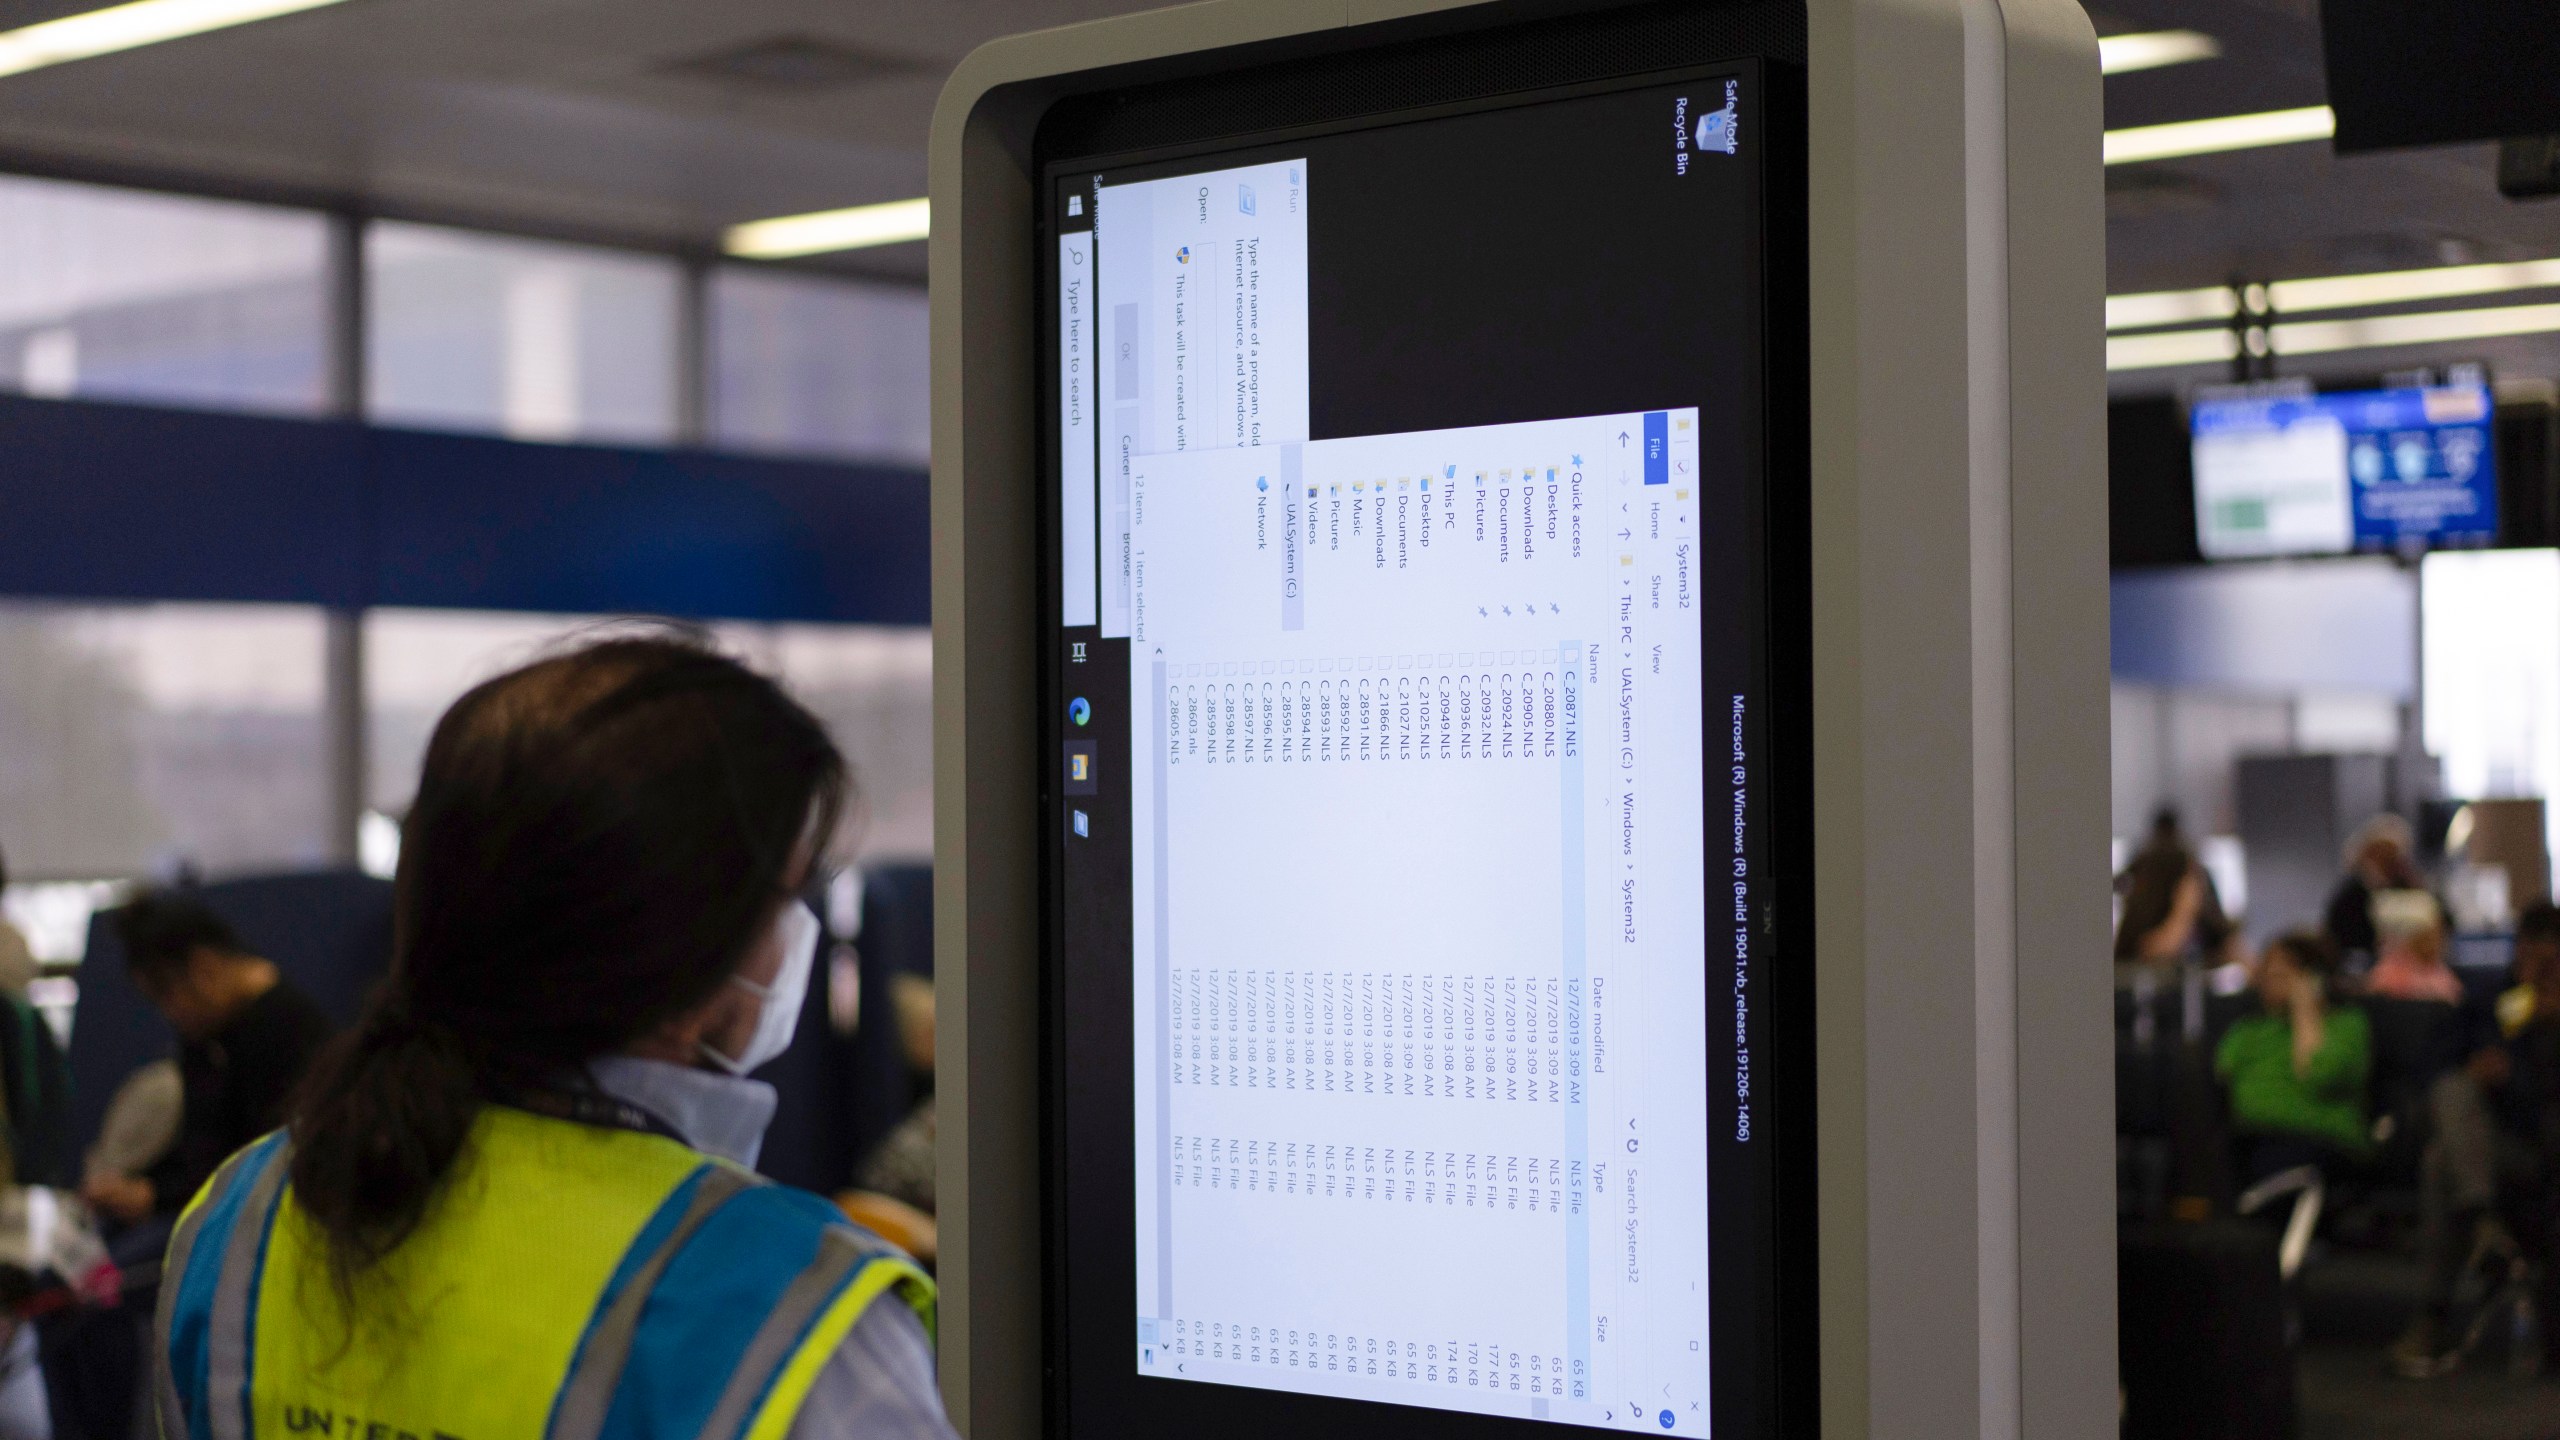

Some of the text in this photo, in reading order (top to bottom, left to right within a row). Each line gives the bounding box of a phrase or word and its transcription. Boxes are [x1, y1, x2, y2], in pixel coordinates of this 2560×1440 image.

[1673, 97, 1689, 176] Recycle Bin
[1725, 79, 1739, 155] Safe Mode
[1197, 186, 1209, 225] Open:
[1289, 188, 1299, 214] Run
[1235, 238, 1245, 289] Internet
[1247, 236, 1260, 267] Type
[1250, 269, 1260, 291] the
[1233, 291, 1244, 351] resource,
[1250, 294, 1258, 330] name
[1250, 332, 1261, 346] of
[1067, 278, 1082, 427] Type here to search
[1121, 342, 1131, 361] OK
[1176, 273, 1187, 452] This task will be created with
[1236, 352, 1247, 377] and
[1250, 349, 1258, 357] a
[1236, 379, 1247, 439] Windows
[1247, 360, 1259, 419] program,
[1122, 434, 1131, 476] Cancel
[1650, 437, 1661, 460] File
[1134, 474, 1145, 526] 12 items
[1257, 496, 1268, 550] Network
[1308, 501, 1319, 545] Videos
[1330, 500, 1341, 551] Pictures
[1353, 498, 1363, 536] Music
[1419, 493, 1432, 548] Desktop
[1444, 481, 1455, 530] This PC
[1475, 489, 1486, 542] Pictures
[1499, 487, 1510, 564] Documents
[1523, 486, 1535, 560] Downloads
[1545, 484, 1559, 540] Desktop
[1570, 471, 1583, 558] Quick access
[1650, 501, 1661, 540] Home
[1284, 503, 1298, 600] UALSystem (C:)
[1375, 496, 1387, 569] Downloads
[1398, 495, 1409, 569] Documents
[1135, 560, 1144, 589] item
[1651, 574, 1662, 610] Share
[1675, 543, 1691, 609] System32
[1136, 591, 1146, 643] selected
[1589, 643, 1600, 684] Name
[1652, 644, 1662, 675] View
[1167, 684, 1180, 765] C_28605.NLS
[1186, 684, 1199, 755] c_28603.nls
[1204, 683, 1217, 764] C_28599.NLS
[1223, 682, 1236, 764] C_28598.NLS
[1242, 682, 1255, 764] C_28597.NLS
[1261, 681, 1274, 763] C_28596.NLS
[1280, 680, 1293, 763] C_28595.NLS
[1299, 680, 1312, 763] C_28594.NLS
[1318, 679, 1331, 762] C_28593.NLS
[1338, 678, 1351, 762] C_28592.NLS
[1358, 678, 1371, 762] C_28591.NLS
[1378, 677, 1391, 761] C_21866.NLS
[1398, 676, 1411, 761] C_21027.NLS
[1418, 675, 1431, 760] C_21025.NLS
[1438, 675, 1451, 760] C_20949.NLS
[1458, 674, 1472, 760] C_20936.NLS
[1479, 673, 1493, 759] C_20932.NLS
[1500, 672, 1513, 759] C_20924.NLS
[1521, 672, 1534, 758] C_20905.NLS
[1542, 671, 1555, 758] C_20880.NLS
[1563, 670, 1577, 758] C_20871.NLS
[1732, 694, 1746, 762] Microsoft
[1619, 594, 1636, 944] This PC UALSystem (C:) Windows System32
[1731, 765, 1746, 786] (R)
[1733, 788, 1747, 854] Windows
[1732, 857, 1747, 878] (R)
[1733, 880, 1748, 922] (Build
[1208, 968, 1220, 1087] 12/7/2019 3:08 AM
[1303, 970, 1315, 1091] 12/7/2019 3:08 AM
[1381, 972, 1394, 1095] 12/7/2019 3:08 AM
[1442, 974, 1455, 1098] 12/7/2019 3:08 AM
[1483, 975, 1496, 1100] 12/7/2019 3:08 AM
[1525, 976, 1538, 1102] 12/7/2019 3:09 AM
[1567, 977, 1581, 1105] 12/7/2019 3:09 AM
[1593, 977, 1605, 1074] Date modified
[1210, 1137, 1221, 1189] NLS File
[1305, 1143, 1316, 1196] NLS File
[1384, 1148, 1395, 1201] NLS File
[1445, 1152, 1456, 1206] NLS File
[1486, 1154, 1498, 1209] NLS File
[1528, 1157, 1540, 1212] NLS File
[1570, 1160, 1582, 1215] NLS File
[1592, 1161, 1607, 1194] Type
[1624, 1168, 1640, 1284] Search System32
[1212, 1322, 1223, 1359] 65 KB
[1307, 1332, 1318, 1369] 65 KB
[1386, 1339, 1397, 1378] 65 KB
[1597, 1315, 1608, 1343] Size
[1447, 1340, 1458, 1384] 174 KB
[1488, 1344, 1500, 1389] 177 KB
[1530, 1354, 1542, 1393] 65 KB
[1573, 1358, 1585, 1398] 65 KB
